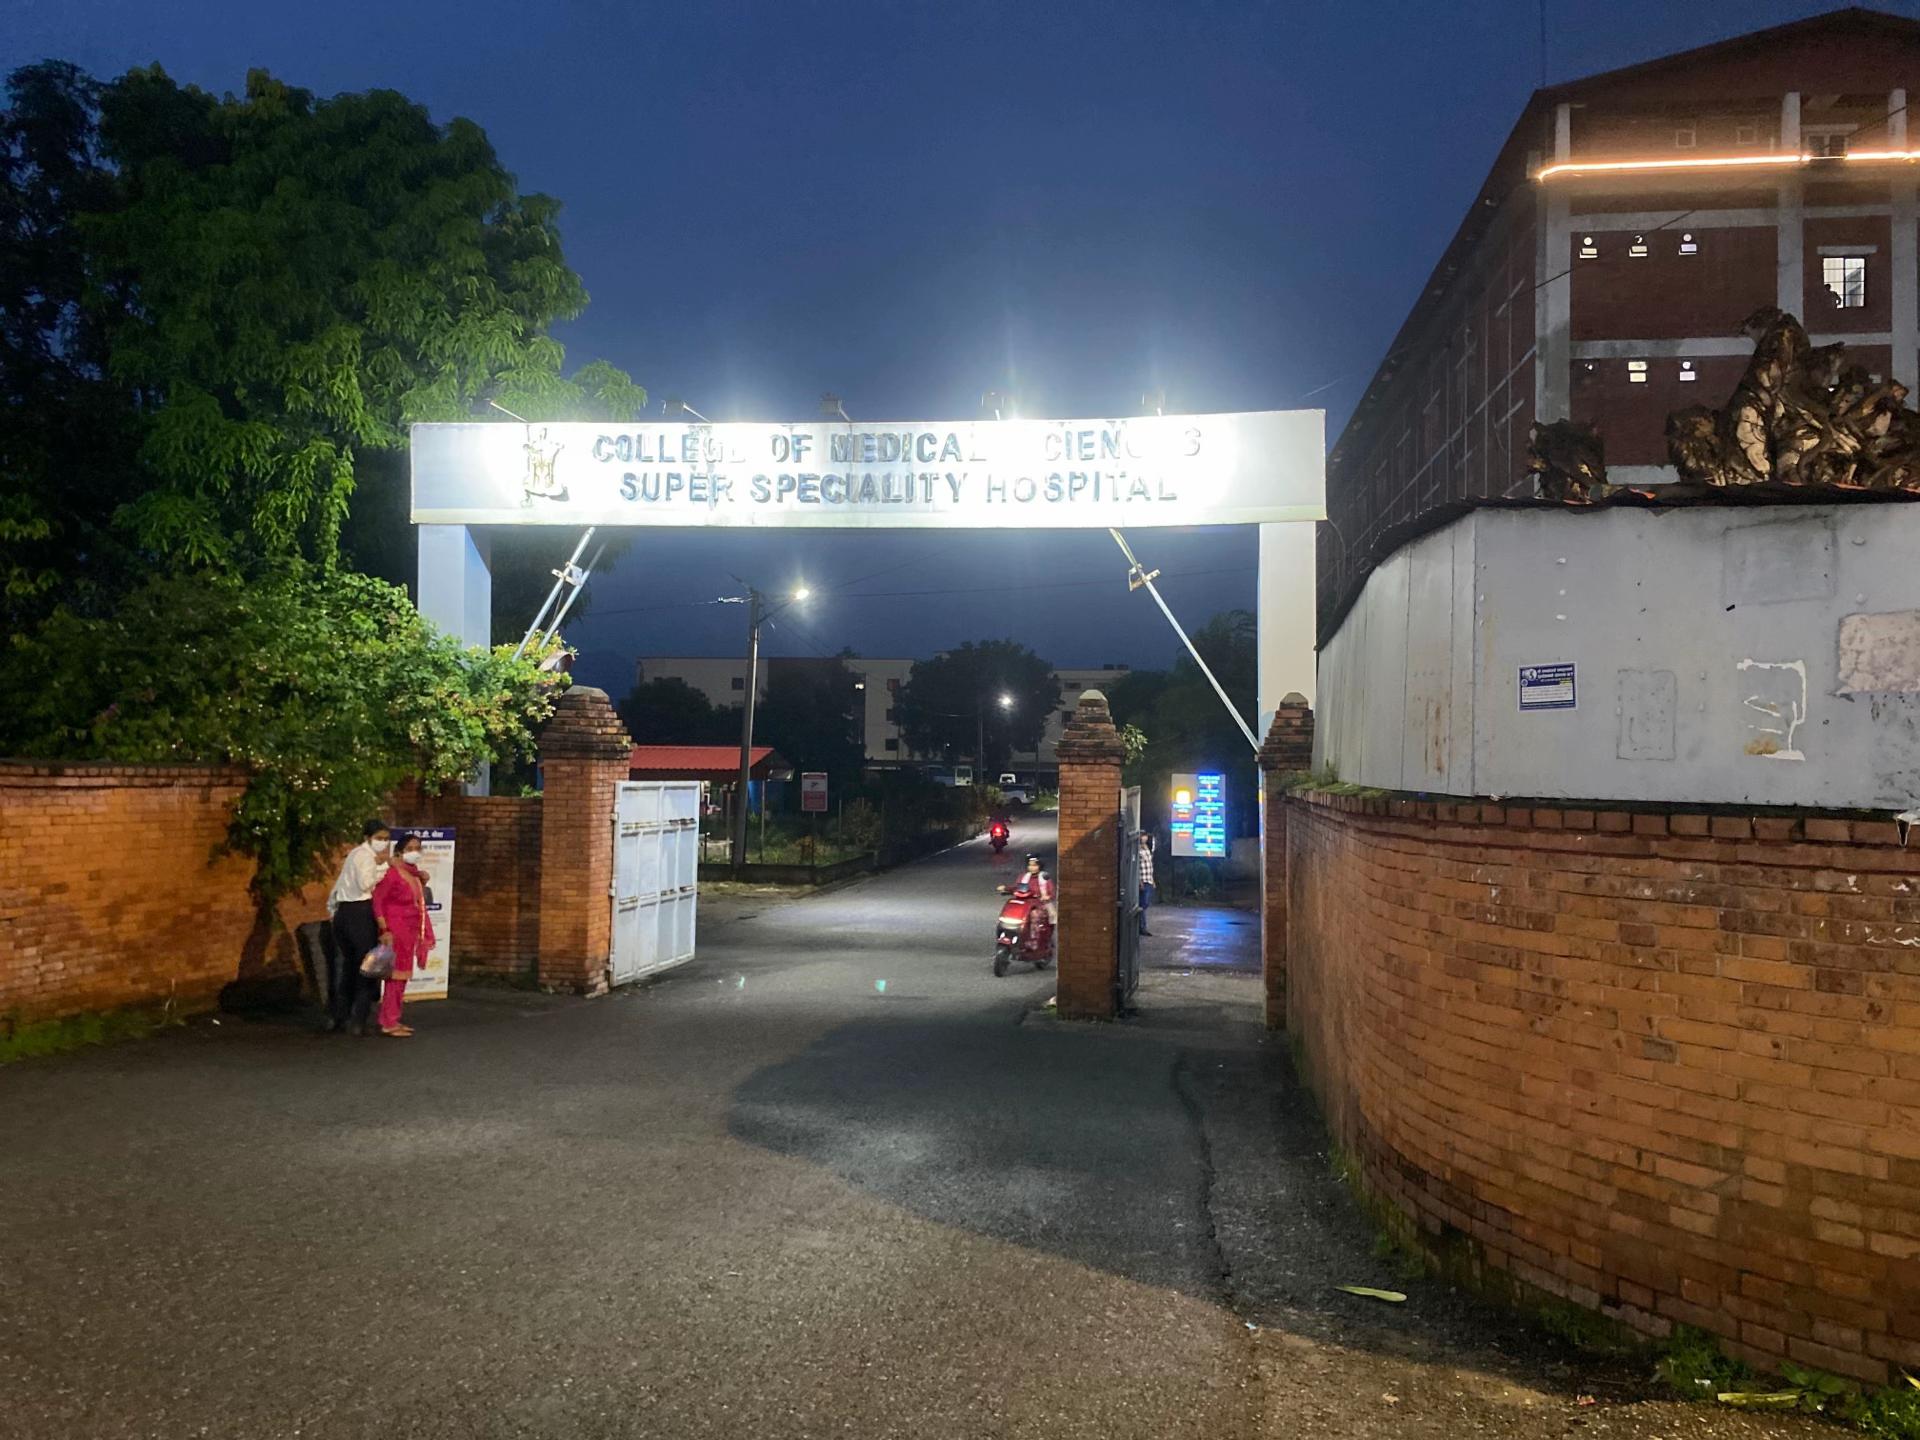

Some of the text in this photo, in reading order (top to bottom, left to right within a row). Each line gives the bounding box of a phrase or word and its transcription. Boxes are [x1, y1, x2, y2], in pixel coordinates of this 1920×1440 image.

[771, 433, 813, 463] OF
[831, 432, 987, 463] MEDICAL
[620, 472, 1178, 503] SUPER SPECIALITY HOSPITAL
